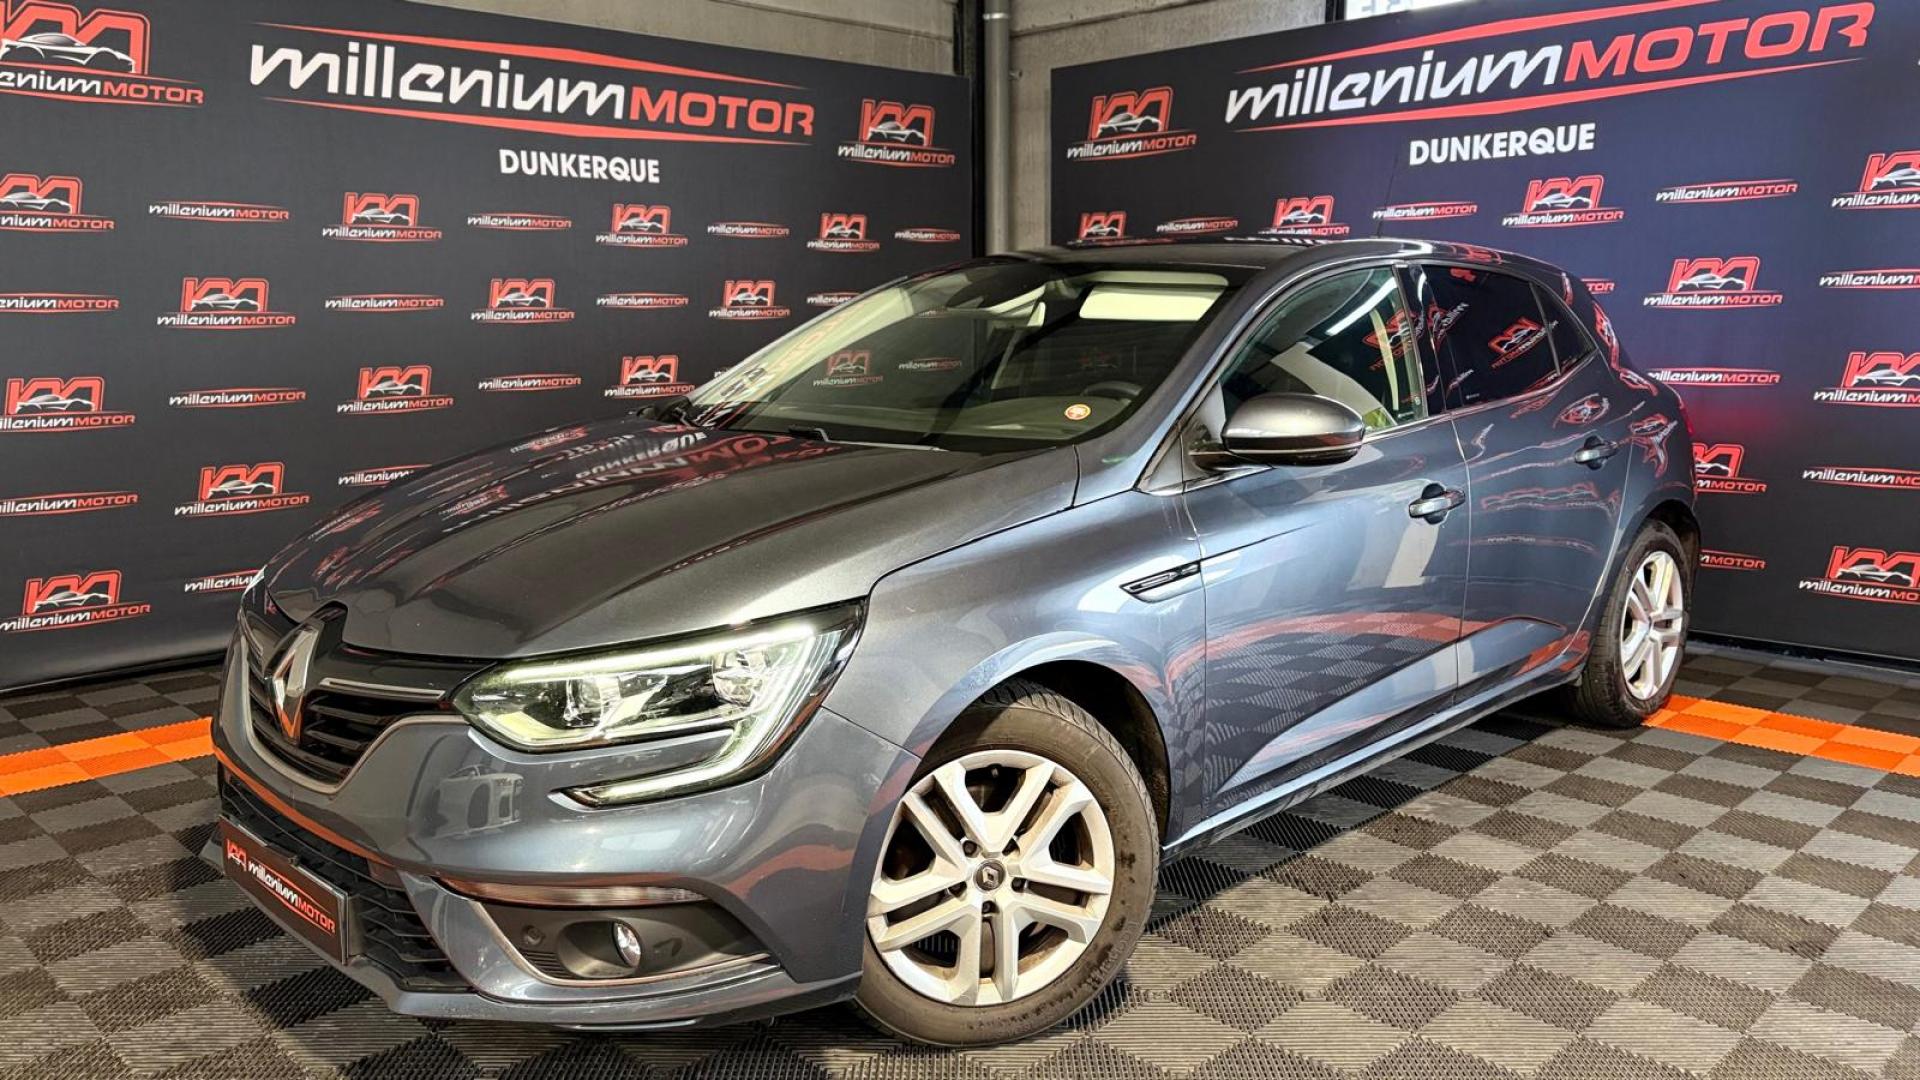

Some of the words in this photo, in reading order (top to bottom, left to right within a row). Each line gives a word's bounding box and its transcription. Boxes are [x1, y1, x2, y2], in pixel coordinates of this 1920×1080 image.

[1225, 2, 1875, 123] milleniumMOTOR
[0, 70, 204, 104] eniumMOTOR
[250, 41, 815, 136] milleniumMOTOR
[1409, 123, 1596, 166] DUNKERQUE
[500, 149, 660, 184] DUNKERQUE
[1831, 190, 1920, 208] millenium
[0, 217, 114, 230] niumMOTOR
[1819, 273, 1920, 287] millenium
[0, 297, 119, 309] niumMOTOR
[1813, 388, 1920, 405] milleniumM
[0, 415, 136, 430] illeniumMOTOR
[338, 470, 410, 486] millenium
[0, 494, 139, 513] illeniumMOTOR
[184, 576, 254, 593] milleniu
[1799, 579, 1920, 602] milleniumMO
